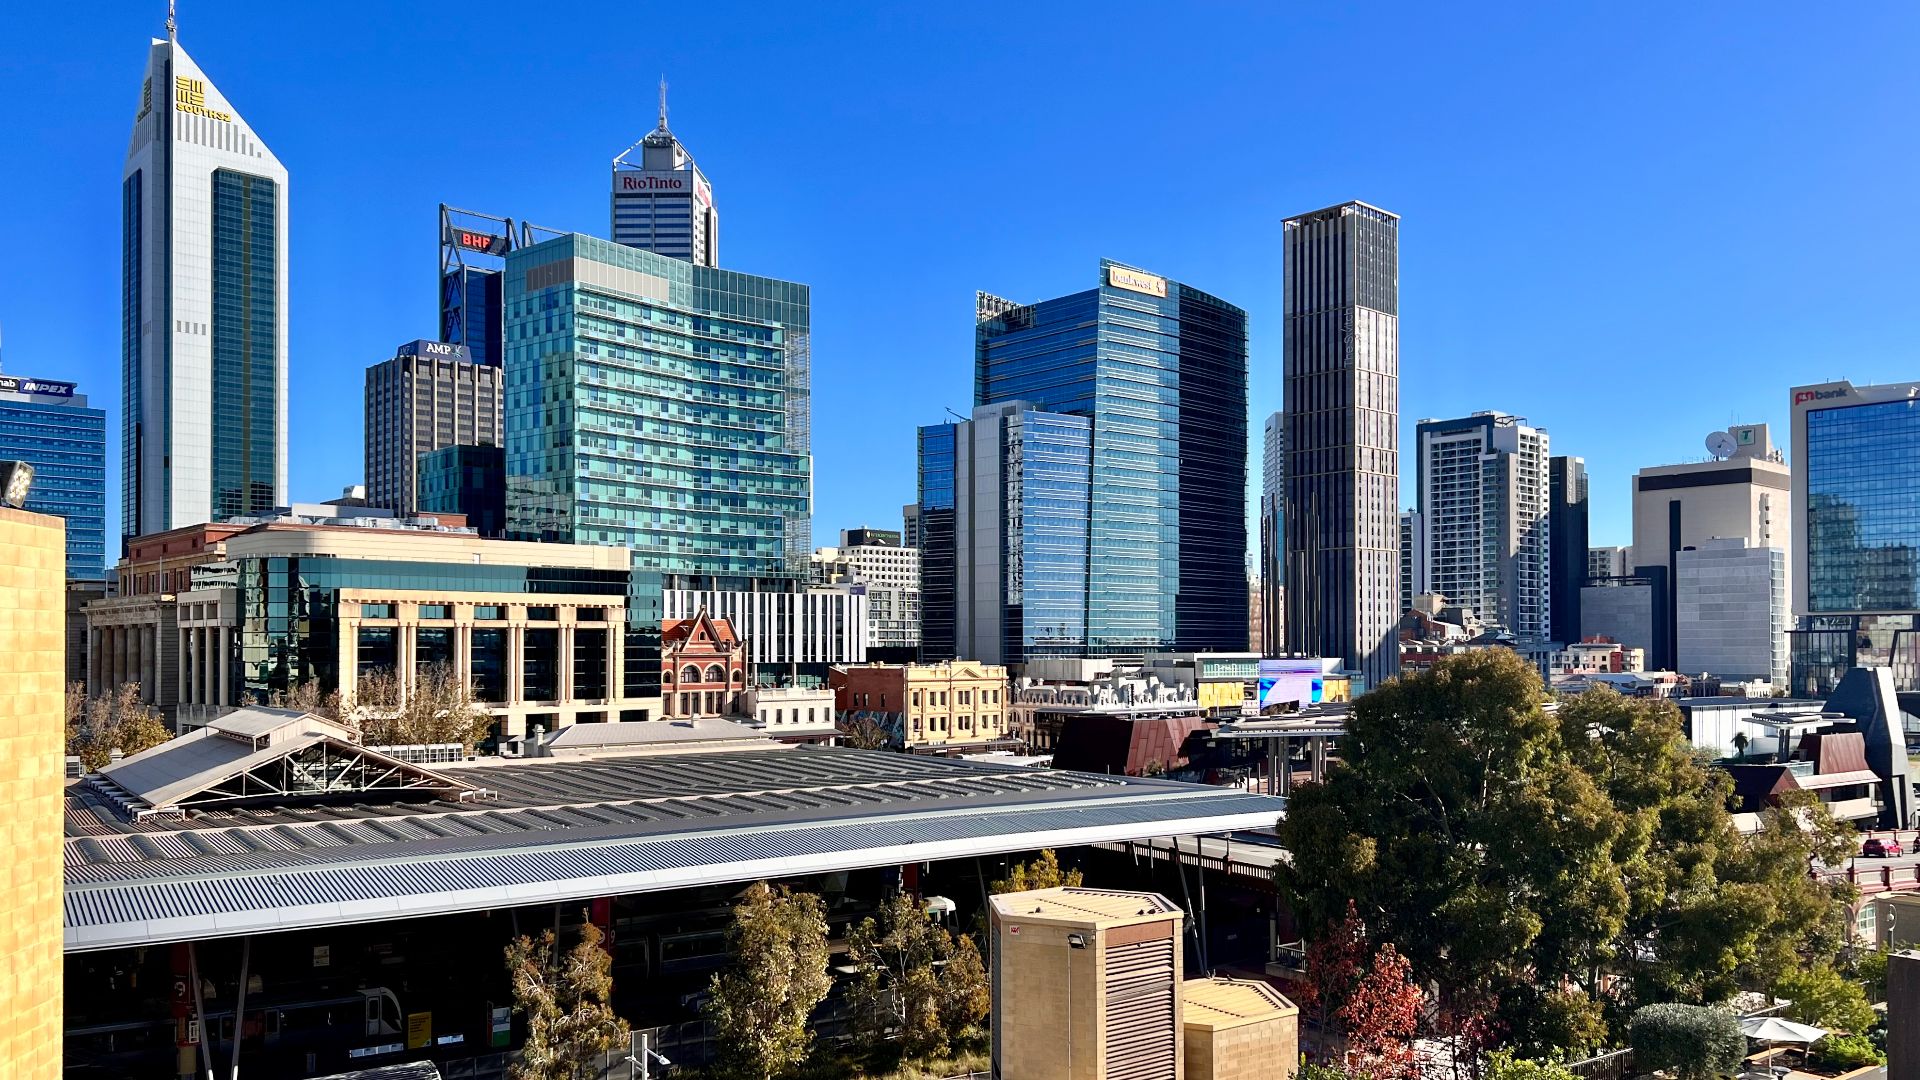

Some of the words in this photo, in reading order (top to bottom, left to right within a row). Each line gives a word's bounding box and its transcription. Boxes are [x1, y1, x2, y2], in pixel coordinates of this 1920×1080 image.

[176, 103, 231, 122] SOUTH32
[426, 343, 451, 355] AMP
[24, 382, 69, 394] INPEX
